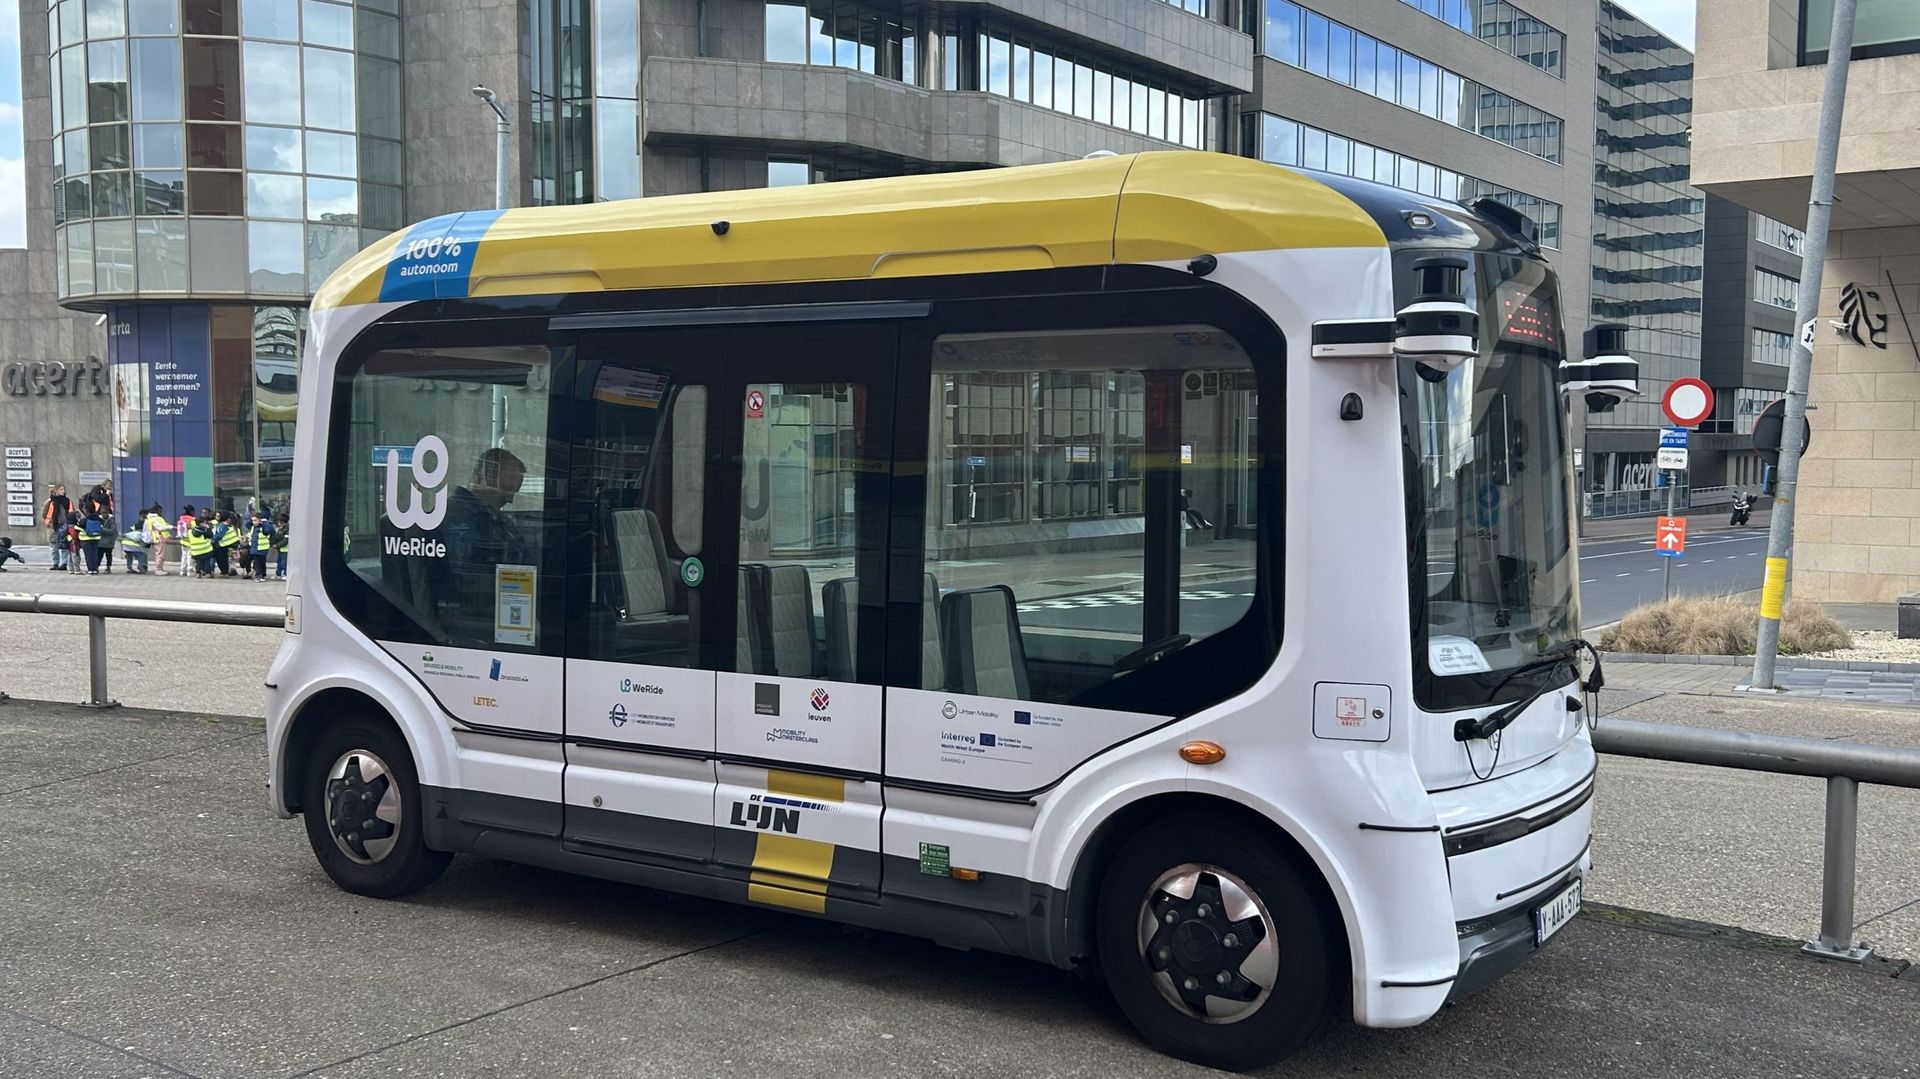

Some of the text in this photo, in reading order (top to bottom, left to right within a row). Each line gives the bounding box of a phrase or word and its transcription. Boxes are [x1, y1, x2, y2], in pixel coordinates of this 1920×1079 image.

[406, 236, 462, 260] 100%
[400, 262, 458, 276] autonoom
[177, 396, 189, 406] bij
[384, 536, 447, 558] WeRide
[632, 684, 664, 694] WeRide
[808, 712, 832, 722] leuven
[977, 710, 999, 719] Mobility
[941, 731, 976, 744] Interreg
[730, 802, 800, 834] LIJN
